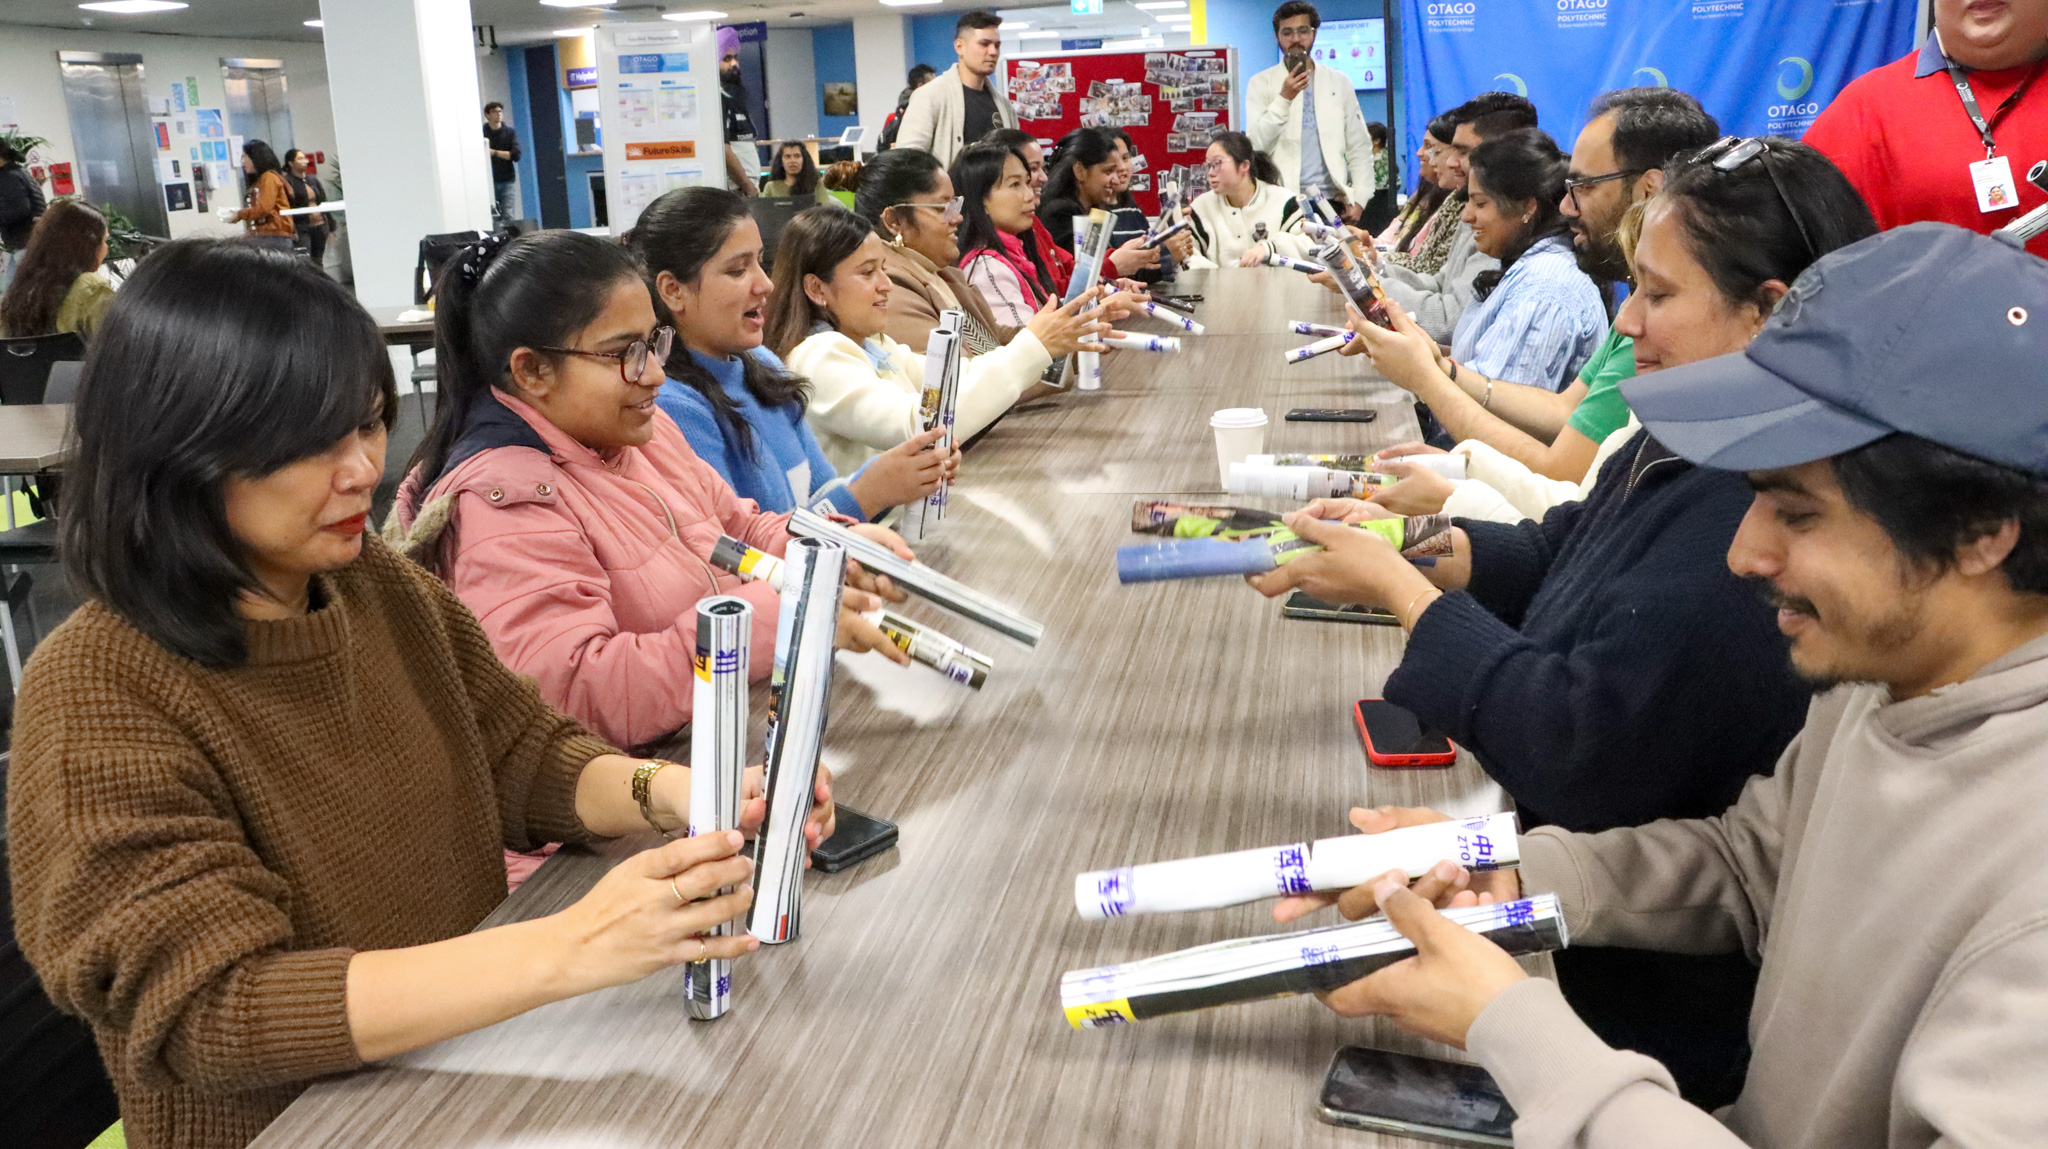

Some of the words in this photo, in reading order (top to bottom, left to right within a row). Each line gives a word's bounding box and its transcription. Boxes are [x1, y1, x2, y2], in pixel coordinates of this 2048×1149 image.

[1427, 2, 1476, 15] OTAGO
[1557, 0, 1608, 10] OTAGO
[1692, 3, 1744, 13] POLYTECHNIC
[1557, 12, 1607, 22] POLYTECHNIC
[1338, 22, 1369, 30] SUPPORT
[1428, 18, 1475, 27] POLYTECHNIC
[1074, 39, 1101, 48] Student
[633, 55, 659, 63] OTAGO
[1768, 102, 1819, 118] OTAGO
[1767, 119, 1815, 130] POLYTECHNI
[643, 145, 692, 155] FutureSkills
[1457, 834, 1471, 861] ZTO
